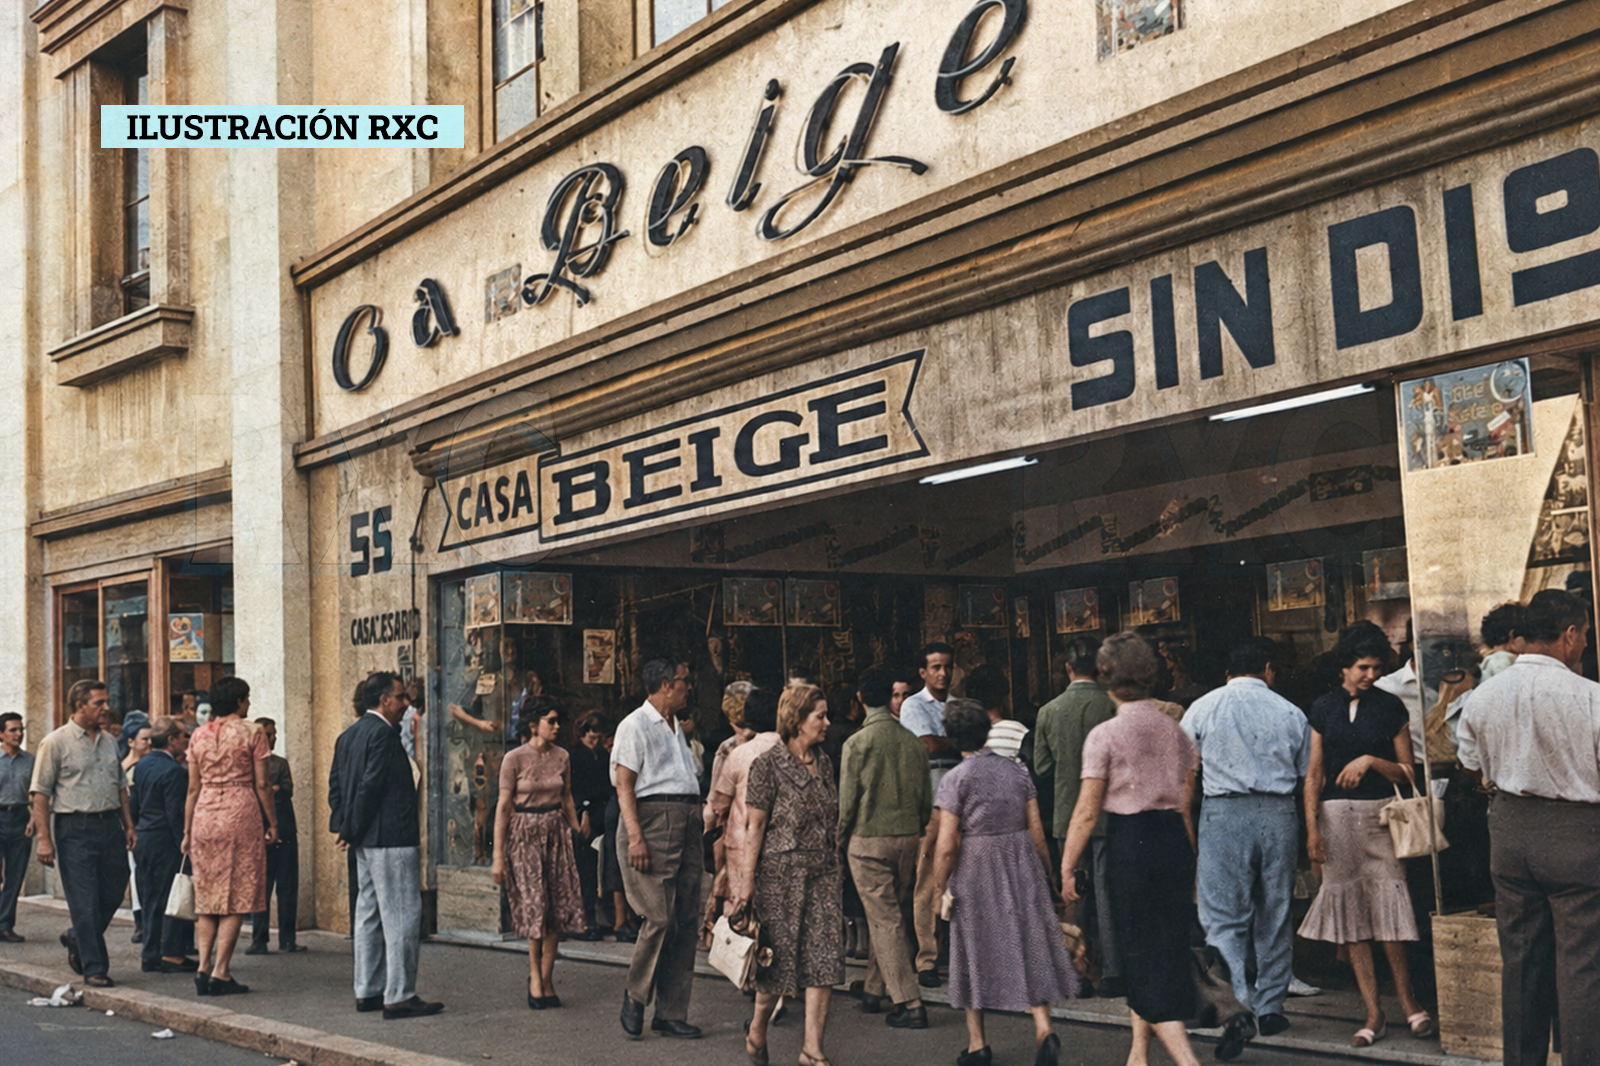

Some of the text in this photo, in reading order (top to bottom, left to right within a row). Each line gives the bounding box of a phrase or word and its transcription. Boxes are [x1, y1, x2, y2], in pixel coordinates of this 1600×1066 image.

[1067, 246, 1276, 411] SIN
[456, 379, 889, 531] CASA BEIGE
